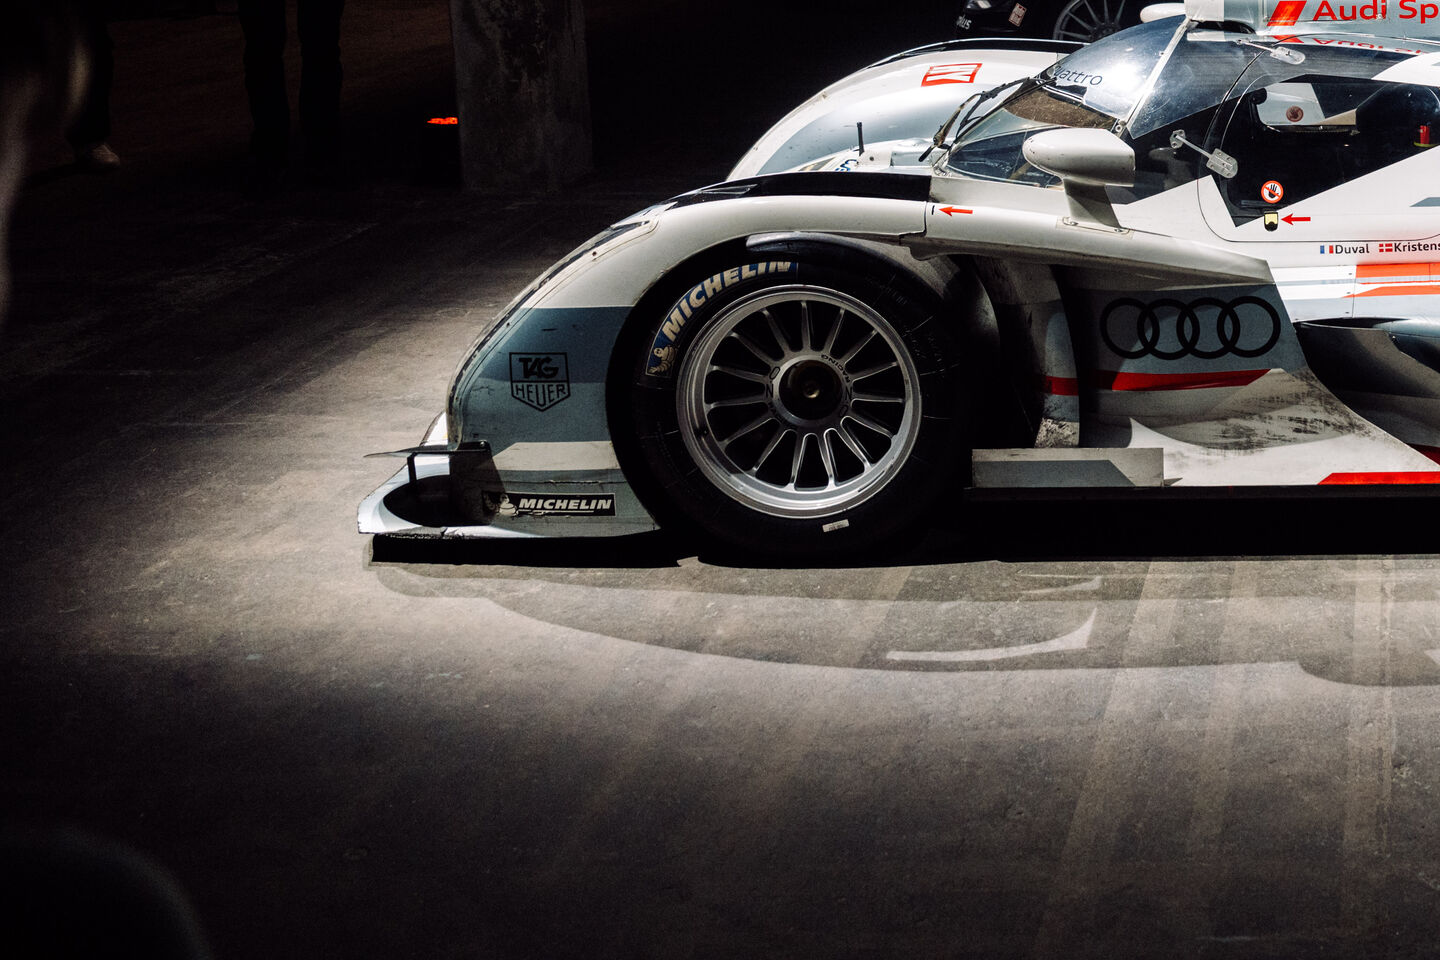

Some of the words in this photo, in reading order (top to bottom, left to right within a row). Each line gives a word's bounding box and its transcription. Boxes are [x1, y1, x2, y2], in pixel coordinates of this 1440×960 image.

[1335, 244, 1370, 255] Duval
[662, 261, 792, 342] MICHELIN
[518, 357, 559, 379] TAG
[515, 384, 567, 408] HEUER
[518, 498, 612, 510] MICHELIN
